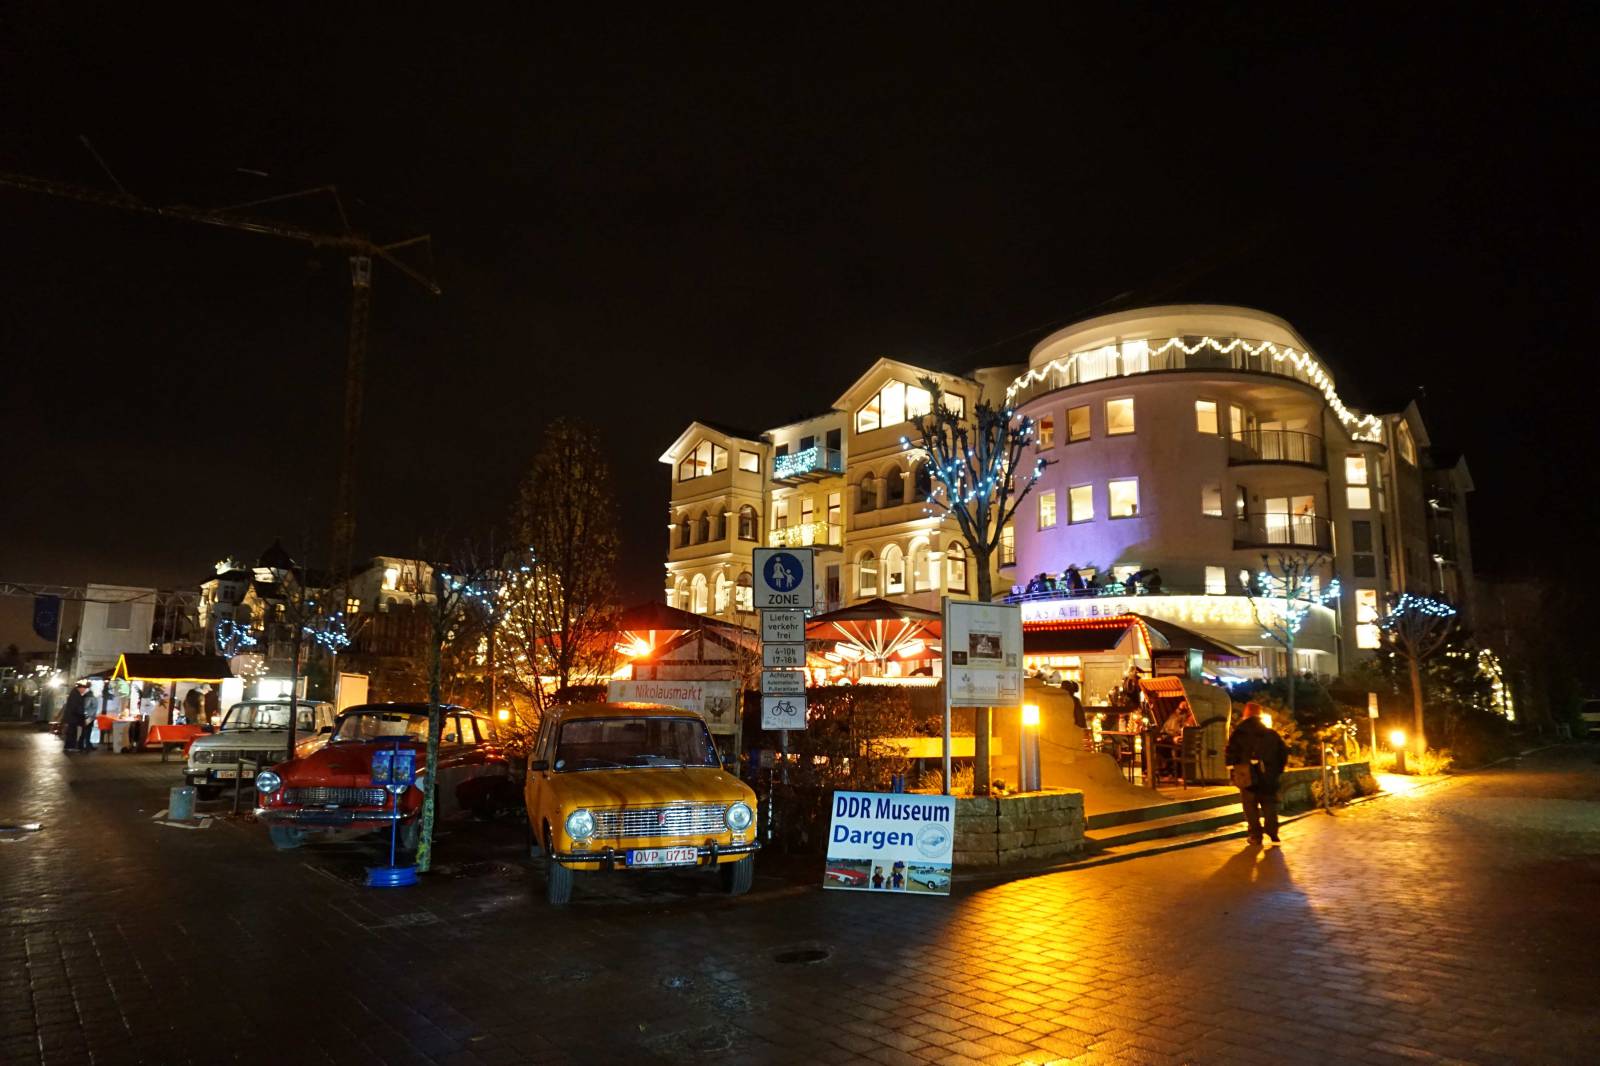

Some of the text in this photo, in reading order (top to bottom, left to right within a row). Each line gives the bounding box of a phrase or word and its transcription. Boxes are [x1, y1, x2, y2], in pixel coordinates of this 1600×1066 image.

[768, 594, 800, 605] ZONE
[769, 613, 797, 621] Liefer-
[768, 622, 799, 631] verkehr
[776, 631, 791, 639] frei
[635, 684, 702, 701] Nikolausmarkt
[836, 796, 950, 822] DDR Museum
[833, 824, 914, 850] Dargen
[635, 851, 659, 863] OVP
